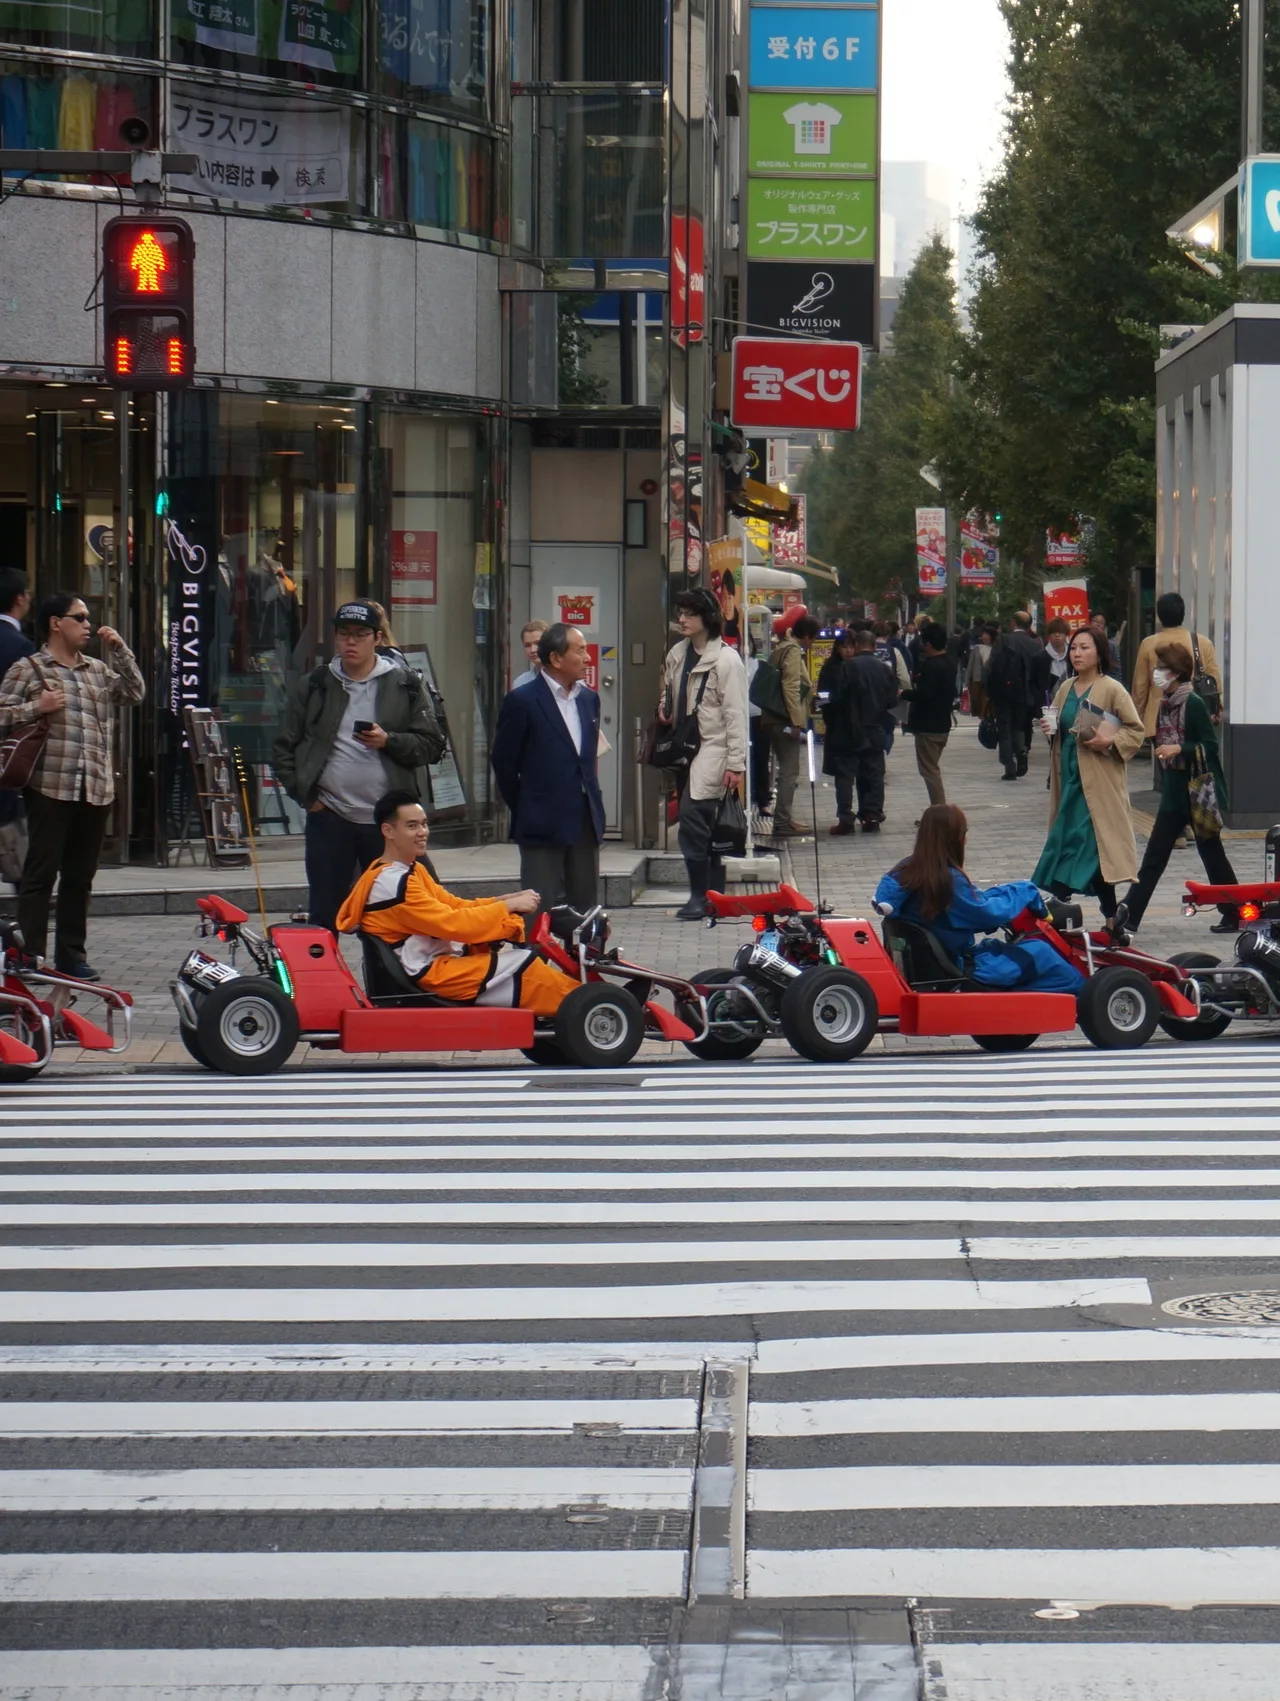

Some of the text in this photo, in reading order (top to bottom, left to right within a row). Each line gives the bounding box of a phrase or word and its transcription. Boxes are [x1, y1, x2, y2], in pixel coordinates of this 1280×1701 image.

[767, 36, 860, 60] 受付6F
[173, 103, 279, 147] プラスワン
[756, 160, 790, 168] ORIGINAL
[794, 161, 826, 169] T-SHIRTS
[756, 220, 868, 246] プラスワン
[779, 317, 841, 328] BIGVISION
[742, 364, 851, 403] 宝くじ
[1051, 604, 1082, 616] TAX
[182, 582, 200, 749] BIGVISI
